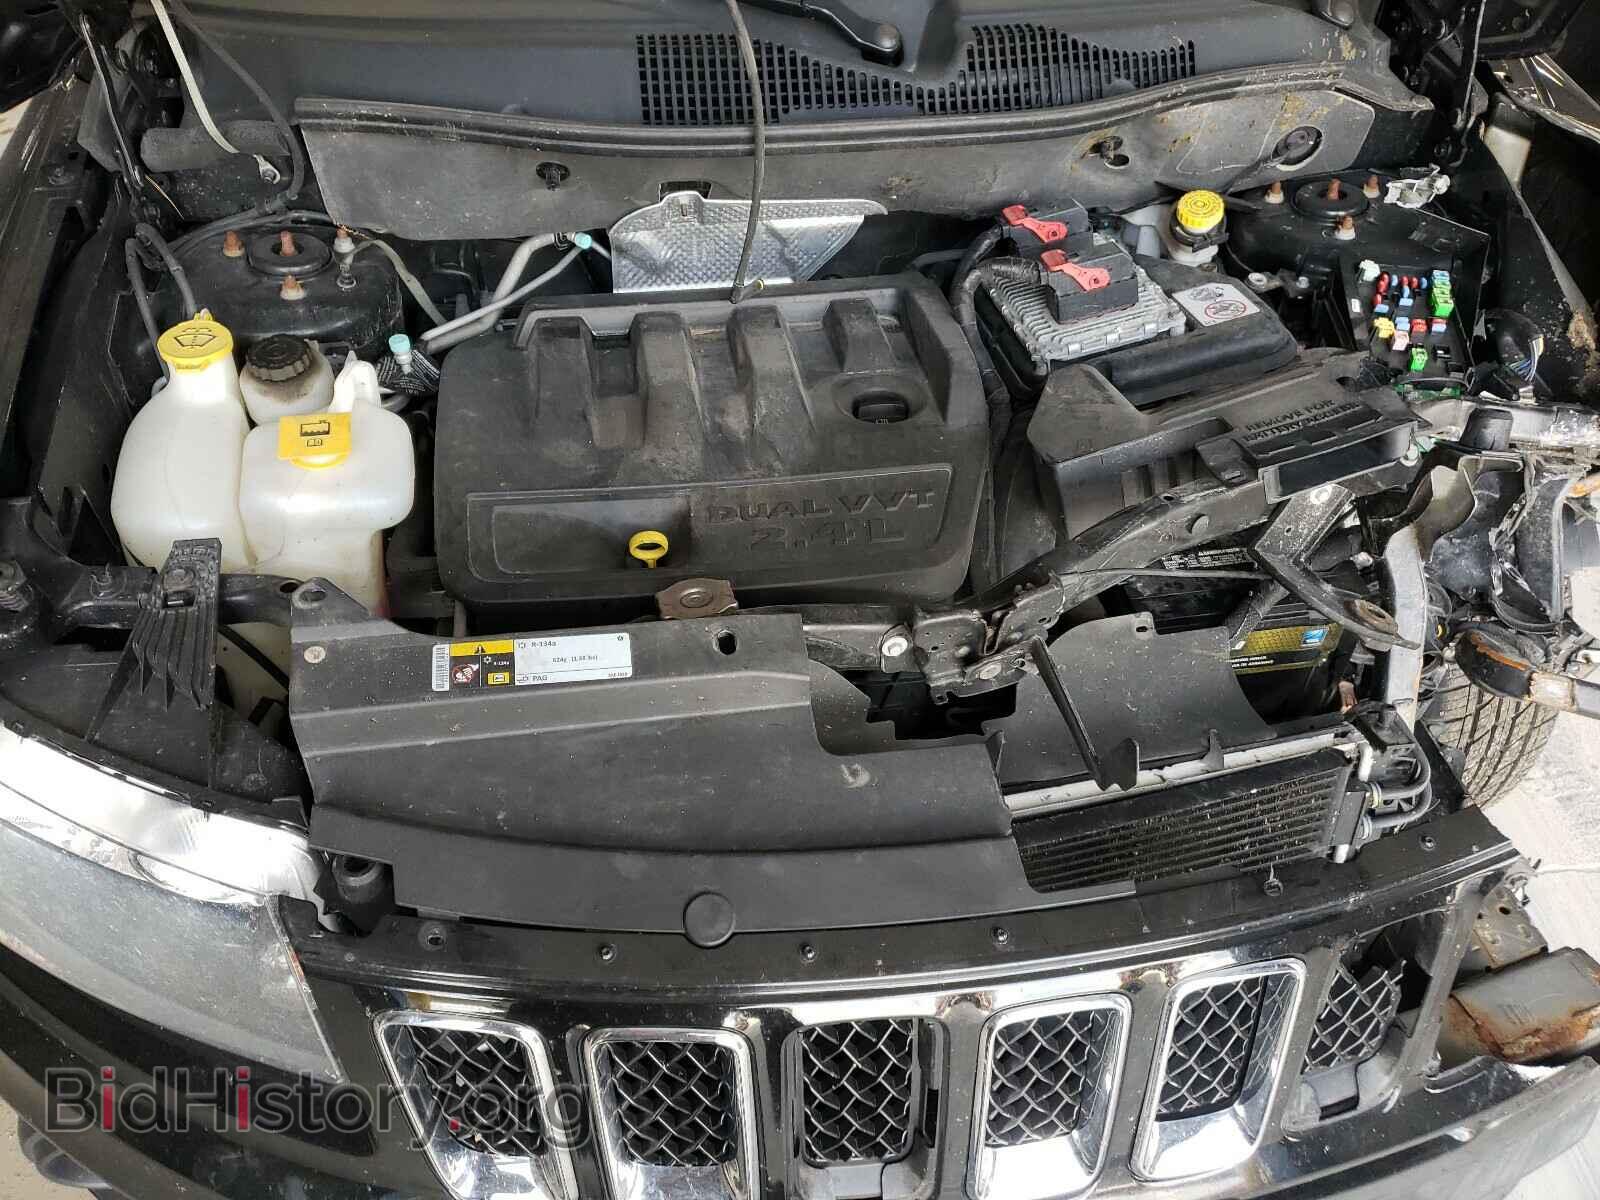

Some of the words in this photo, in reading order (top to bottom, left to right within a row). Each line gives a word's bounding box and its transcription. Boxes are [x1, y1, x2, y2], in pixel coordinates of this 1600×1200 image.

[1245, 408, 1303, 431] REMOVE
[1305, 398, 1336, 414] FOR
[708, 498, 832, 525] DUAL
[838, 487, 936, 515] VVT
[750, 519, 905, 551] 2.4L
[531, 640, 557, 648] R-134a
[532, 674, 548, 682] PAG
